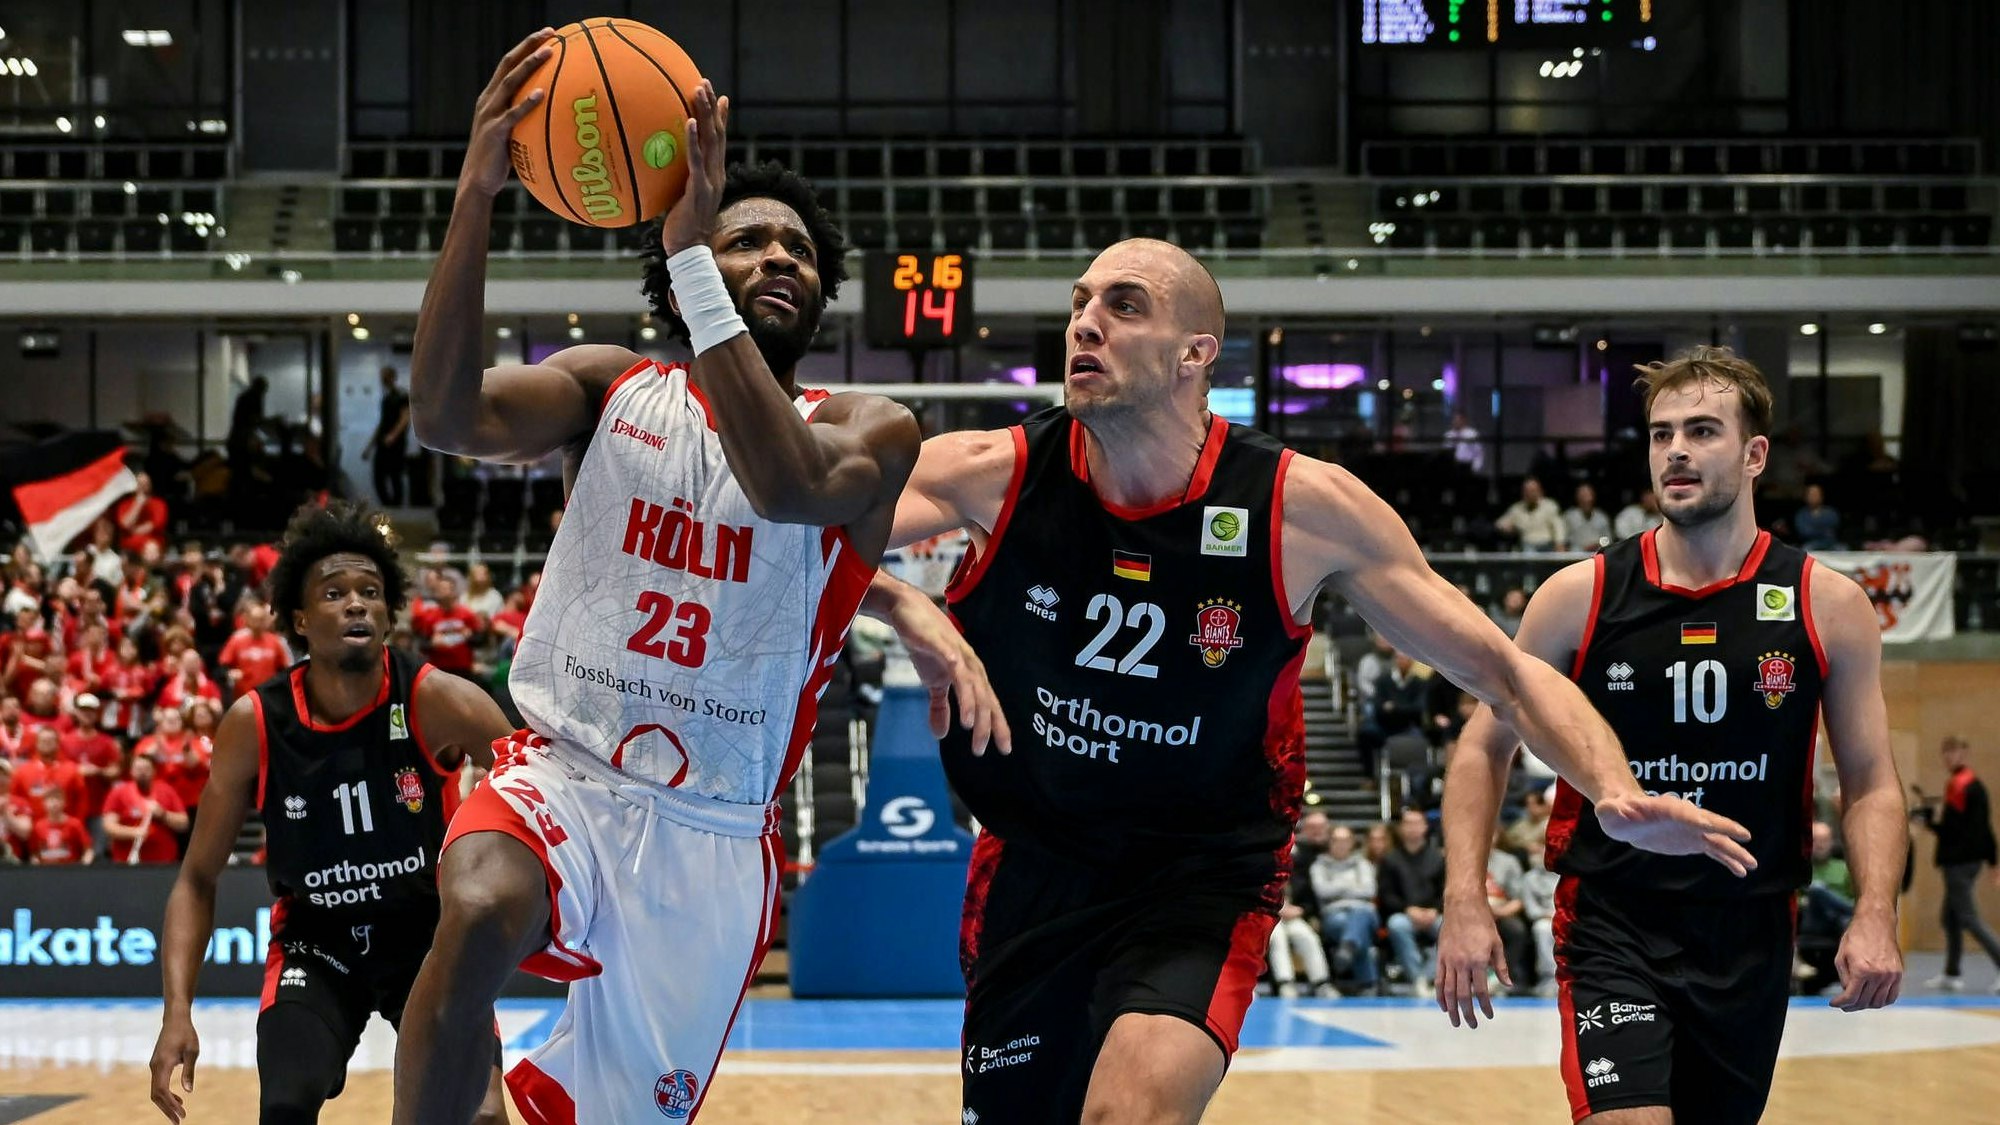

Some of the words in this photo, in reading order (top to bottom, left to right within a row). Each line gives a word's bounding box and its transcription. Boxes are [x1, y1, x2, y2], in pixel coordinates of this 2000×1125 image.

[572, 94, 623, 221] Wilson
[904, 289, 955, 337] 14
[610, 418, 668, 451] SPALDING
[622, 497, 754, 583] KÖLN
[626, 590, 712, 669] 23
[1025, 601, 1058, 622] errea
[1204, 623, 1231, 640] GIANTS
[1075, 593, 1166, 679] 22
[564, 655, 653, 699] Flossbach
[658, 688, 697, 713] von
[1607, 681, 1635, 691] errea
[1665, 659, 1728, 724] 10
[1032, 712, 1121, 764] sport
[1036, 686, 1201, 746] orthomol
[1628, 753, 1768, 782] orthomol
[333, 780, 374, 835] 11
[304, 846, 426, 888] orthomol
[309, 882, 382, 908] sport
[280, 978, 307, 988] errea
[1588, 1073, 1620, 1088] errea
